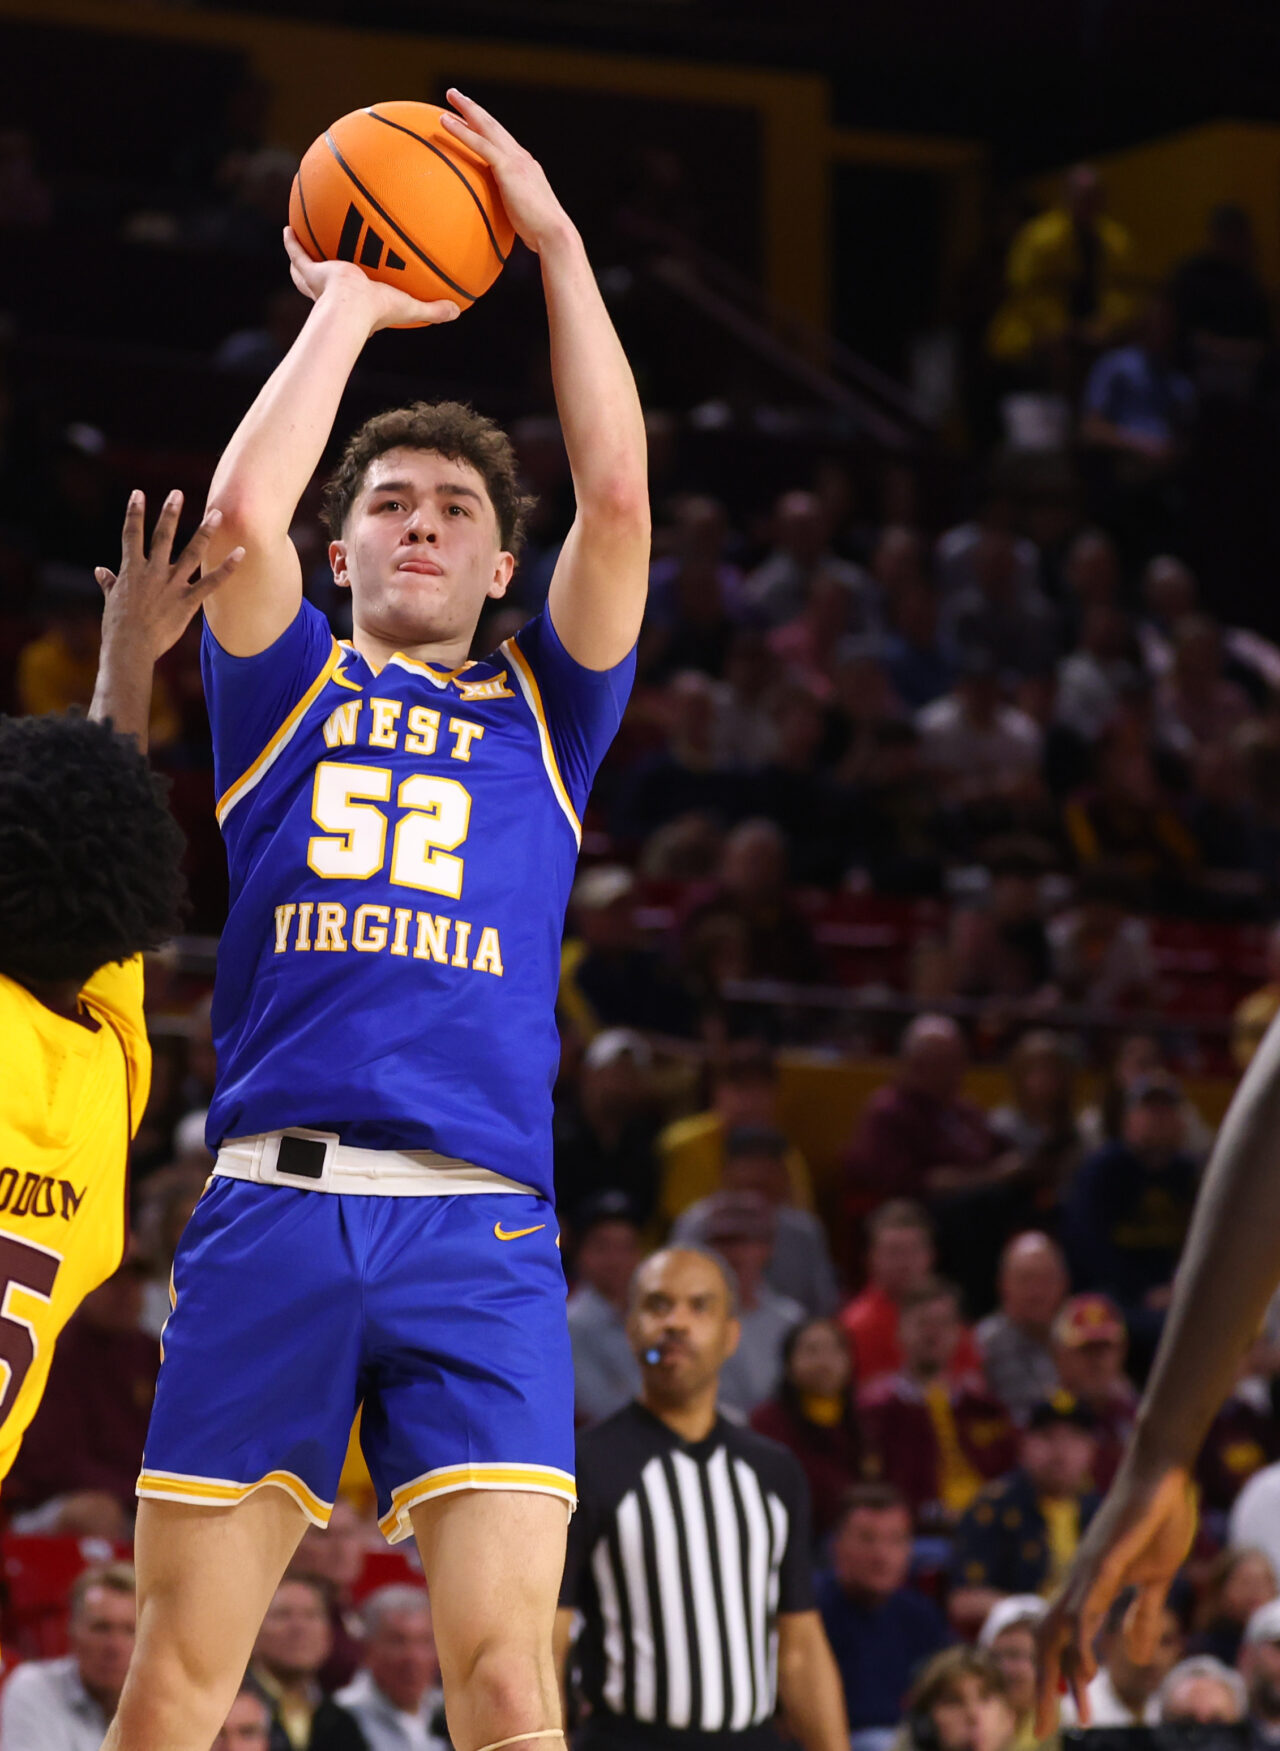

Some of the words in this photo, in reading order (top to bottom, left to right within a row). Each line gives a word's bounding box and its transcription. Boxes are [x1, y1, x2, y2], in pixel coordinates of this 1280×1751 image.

[322, 697, 484, 762] WEST
[307, 761, 472, 900] 52
[274, 902, 503, 977] VIRGINIA
